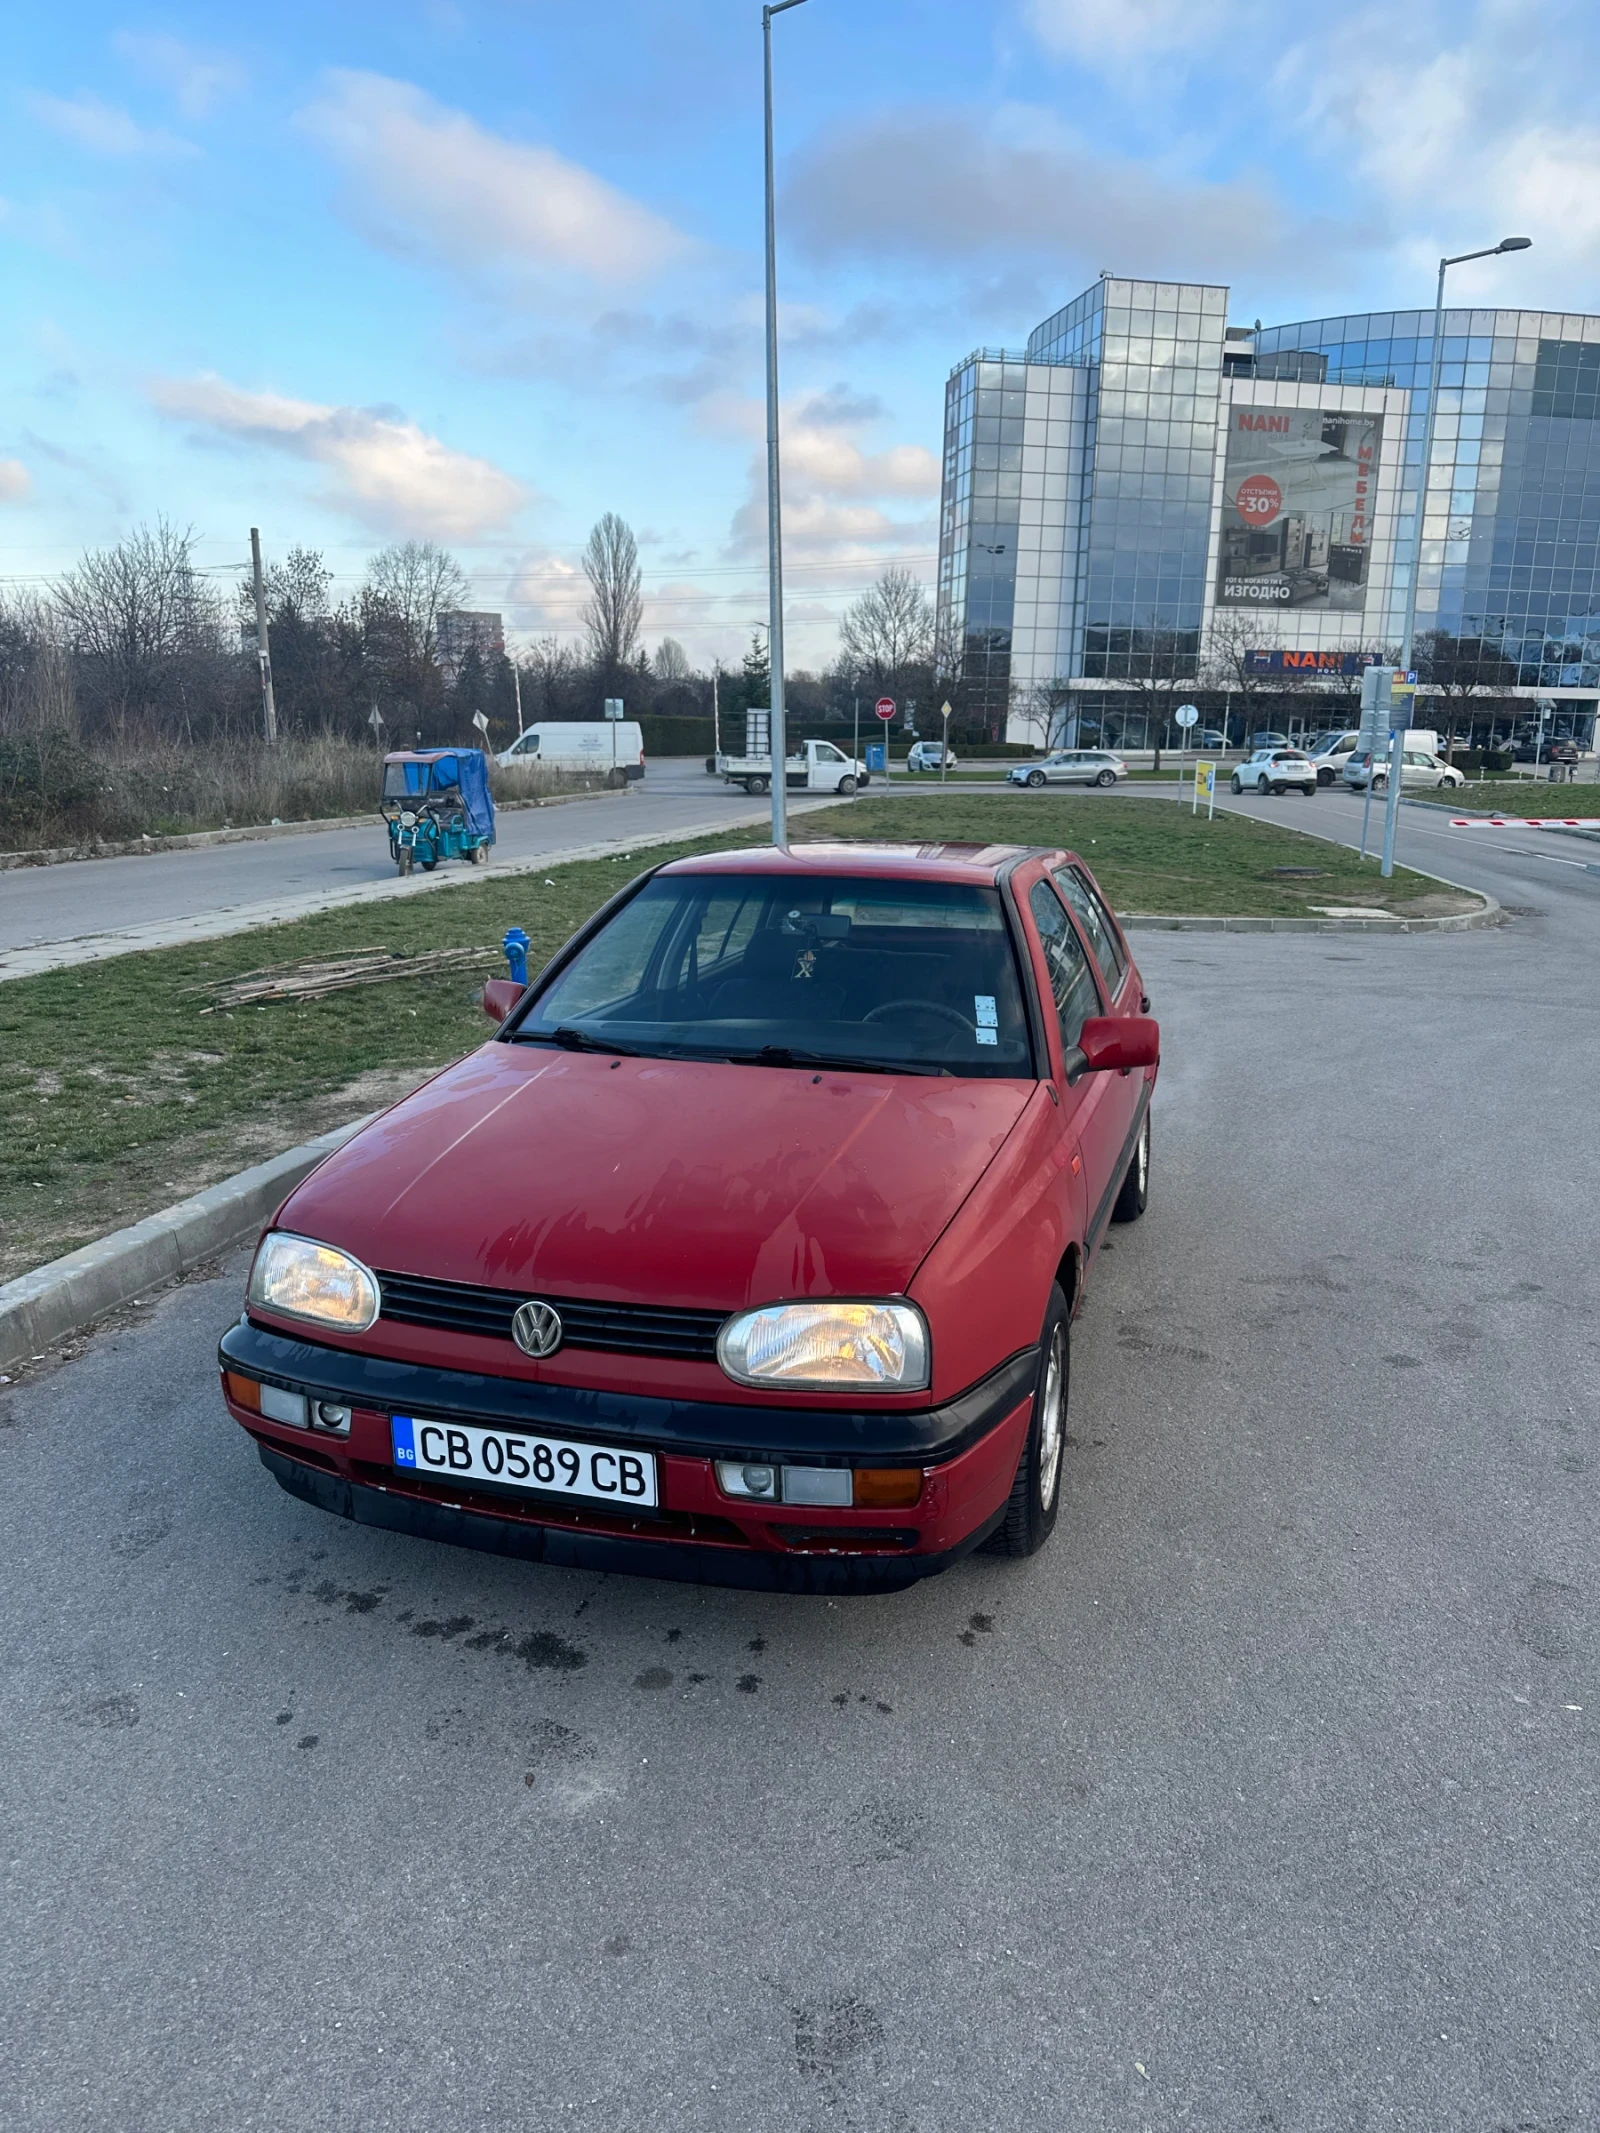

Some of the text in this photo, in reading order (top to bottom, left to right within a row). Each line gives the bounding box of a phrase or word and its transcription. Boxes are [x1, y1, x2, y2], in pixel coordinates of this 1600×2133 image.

[1238, 413, 1290, 432] NANI
[1322, 416, 1375, 427] nanihome.bg
[1224, 585, 1290, 600] ИЗГОДНО
[1283, 651, 1344, 668] NANI
[1407, 673, 1415, 683] P
[878, 704, 893, 713] STOP
[397, 1448, 414, 1460] BG
[420, 1427, 646, 1497] CB 0589 CB
